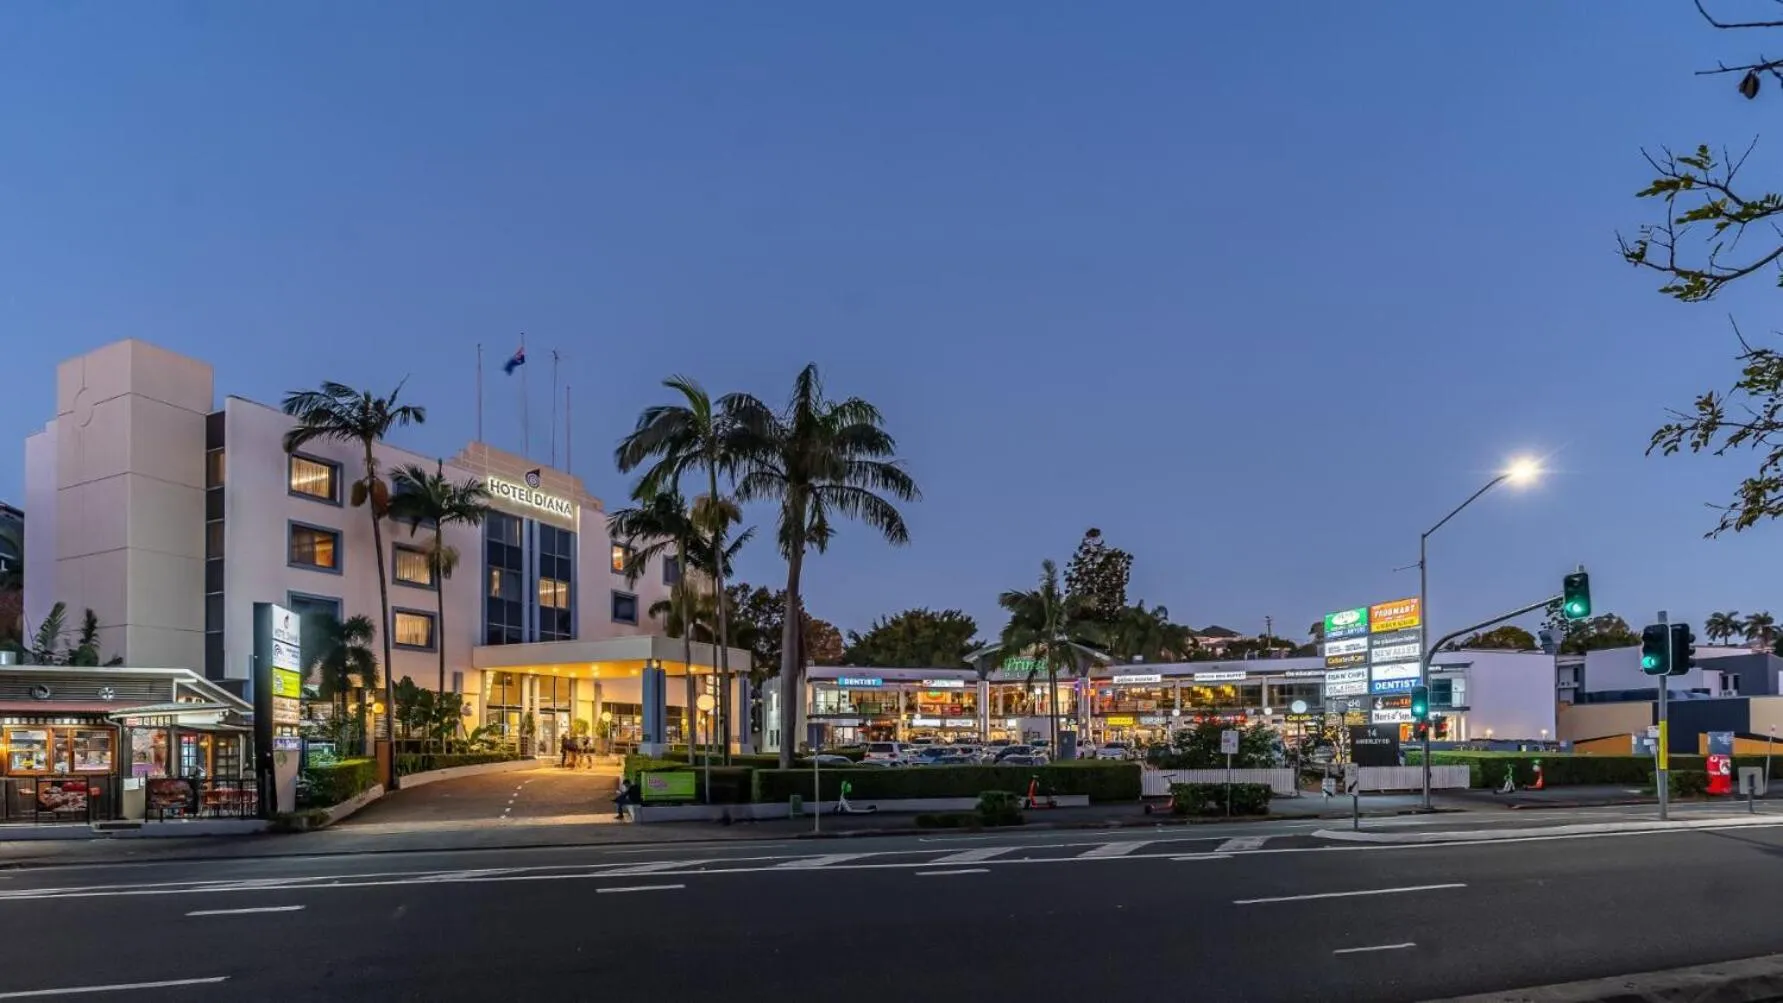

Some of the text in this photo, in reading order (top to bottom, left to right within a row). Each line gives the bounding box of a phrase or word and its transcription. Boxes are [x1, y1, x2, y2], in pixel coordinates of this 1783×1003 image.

[489, 478, 572, 516] HOTEL DIANA
[844, 678, 877, 686] DENTIST
[1375, 679, 1417, 691] DENTIST
[1367, 729, 1378, 737] 14
